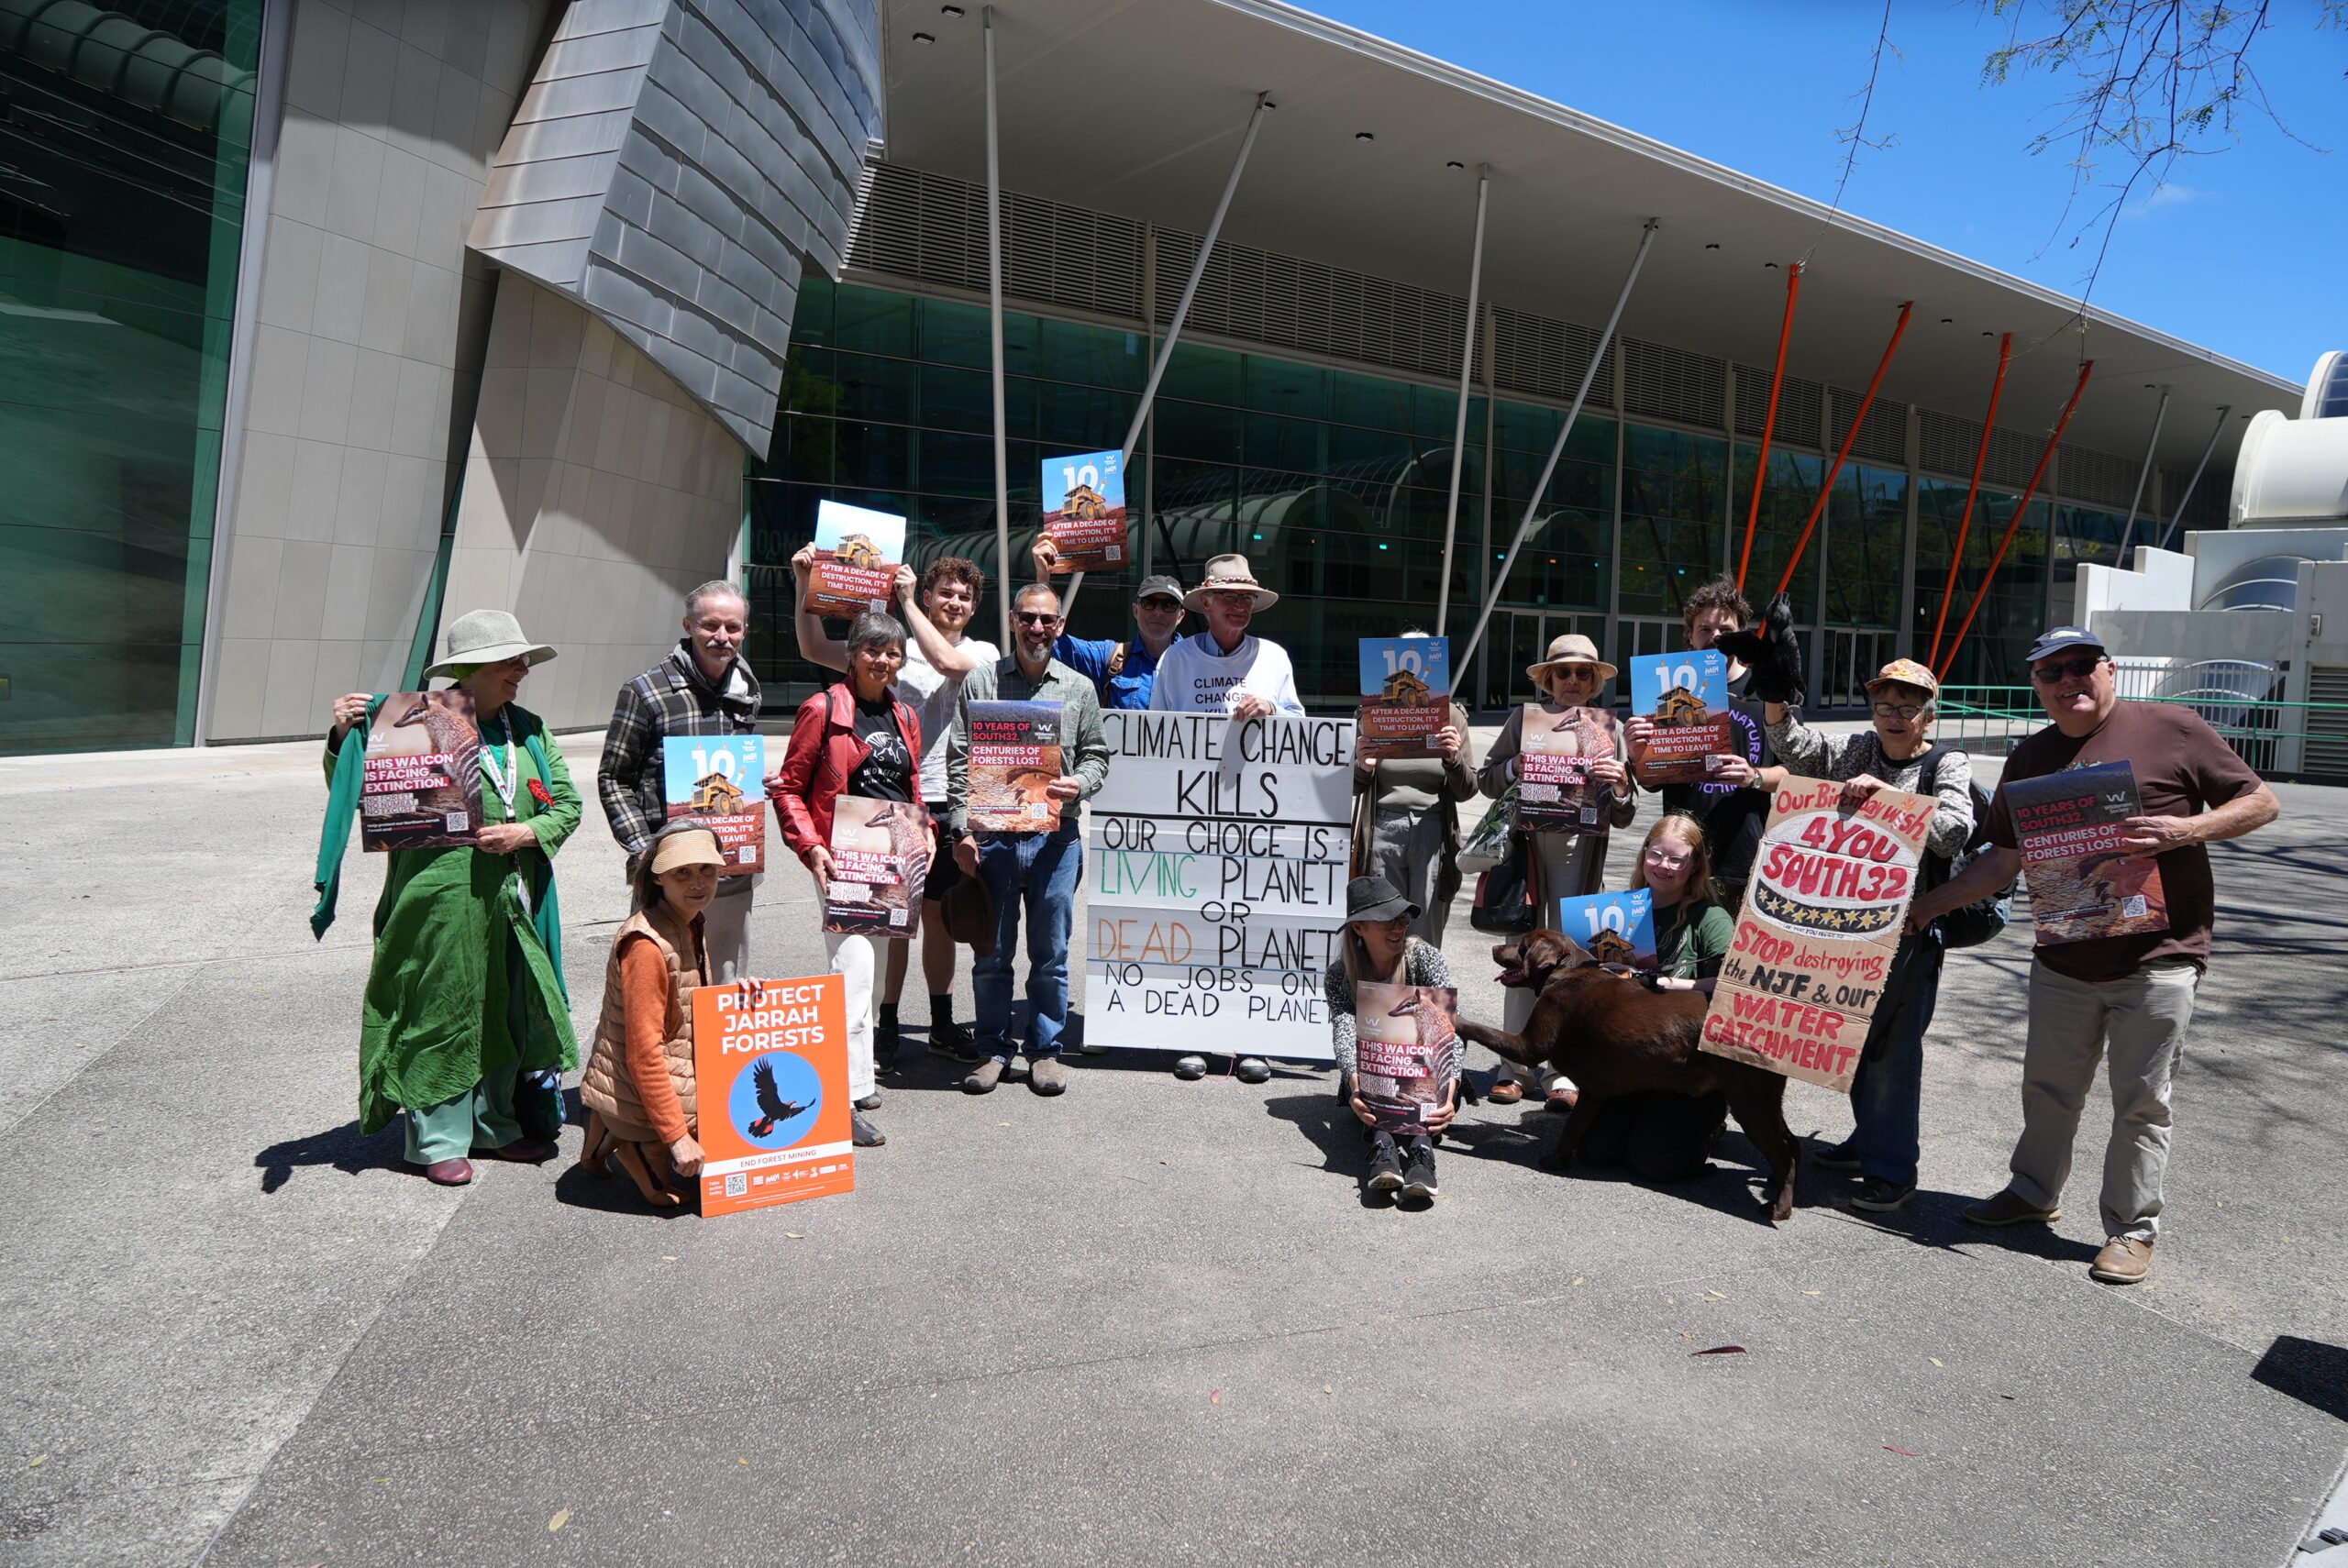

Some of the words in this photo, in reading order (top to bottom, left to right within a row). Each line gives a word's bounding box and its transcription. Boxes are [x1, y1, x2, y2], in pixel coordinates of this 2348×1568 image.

[1051, 522, 1072, 531] AFTER
[1079, 520, 1107, 528] DECADE
[1053, 528, 1103, 537] DESTRUCTION,
[1088, 536, 1112, 544] LEAVE!
[820, 564, 846, 573] AFTER
[850, 568, 880, 579] DECADE
[880, 572, 891, 580] OF
[821, 572, 873, 586] DESTRUCTION,
[826, 581, 845, 590] TIME
[855, 584, 880, 595] LEAVE!
[1194, 677, 1246, 689] CLIMATE
[1195, 692, 1246, 704] CHANG
[972, 722, 983, 731] 10
[985, 722, 1016, 731] YEARS
[1017, 723, 1031, 731] OF
[1676, 726, 1708, 735] DECADE
[972, 732, 1020, 741] SOUTH32.
[1102, 713, 1228, 761] CLIMATE
[1240, 719, 1352, 767] CHANGE
[1729, 710, 1761, 764] NATURE
[972, 745, 1024, 756] CENTURIES
[1026, 746, 1040, 756] OF
[1653, 745, 1672, 754] TIME
[1686, 744, 1712, 752] LEAVE!
[364, 757, 394, 770] THIS
[394, 756, 420, 767] WA
[420, 753, 454, 765] ICON
[972, 756, 1014, 765] FORESTS
[1016, 756, 1043, 766] LOST.
[1524, 754, 1547, 764] THIS
[1547, 756, 1565, 765] WA
[1567, 756, 1593, 767] ICON
[364, 770, 377, 782] IS
[379, 767, 430, 779] FACING
[1534, 764, 1573, 774] FACING
[365, 777, 449, 793] EXTINCTION.
[1523, 773, 1585, 785] EXTINCTION.
[382, 793, 411, 801] FOREST
[1177, 769, 1279, 818] KILLS
[1777, 790, 1815, 814] Our
[2017, 808, 2031, 820] 10
[2032, 800, 2076, 816] YEARS
[2077, 796, 2097, 808] OF
[712, 815, 744, 824] DECADE
[720, 834, 748, 843] LEAVE!
[1103, 818, 1157, 852] OUR
[1186, 821, 1286, 857] CHOICE
[2023, 828, 2098, 849] CENTURIES
[2099, 823, 2117, 836] OF
[836, 849, 858, 861] THIS
[860, 852, 879, 863] WA
[880, 854, 906, 865] ICON
[2026, 842, 2086, 862] FORESTS
[846, 861, 886, 872] FACING
[1101, 850, 1197, 898] LIVING
[1221, 856, 1344, 905] PLANET
[1201, 900, 1251, 924] OR
[1098, 918, 1192, 963] DEAD
[1219, 924, 1336, 972] PLANET
[1733, 921, 1795, 966] STOP
[1793, 944, 1885, 981] destroying
[1105, 963, 1144, 987] NO
[1178, 966, 1254, 993] JOBS
[1282, 972, 1317, 996] ON
[1723, 957, 1747, 980] the
[1749, 965, 1811, 999] NJF
[1811, 984, 1832, 1004] &
[717, 984, 825, 1012] PROTECT
[1107, 988, 1124, 1012] A
[1146, 989, 1220, 1017] DEAD
[724, 1006, 819, 1032] JARRAH
[1733, 992, 1845, 1040] WATER
[721, 1025, 825, 1055] FORESTS
[1360, 1041, 1383, 1052] THIS
[1384, 1044, 1404, 1055] WA
[1406, 1045, 1434, 1055] ICON
[1703, 1014, 1856, 1076] CATCHMENT
[1360, 1051, 1369, 1060] IS
[1370, 1053, 1412, 1066] FACING
[1360, 1061, 1426, 1077] EXTINCTION.
[740, 1159, 757, 1168] END
[758, 1154, 786, 1165] FOREST
[788, 1149, 817, 1159] MINING
